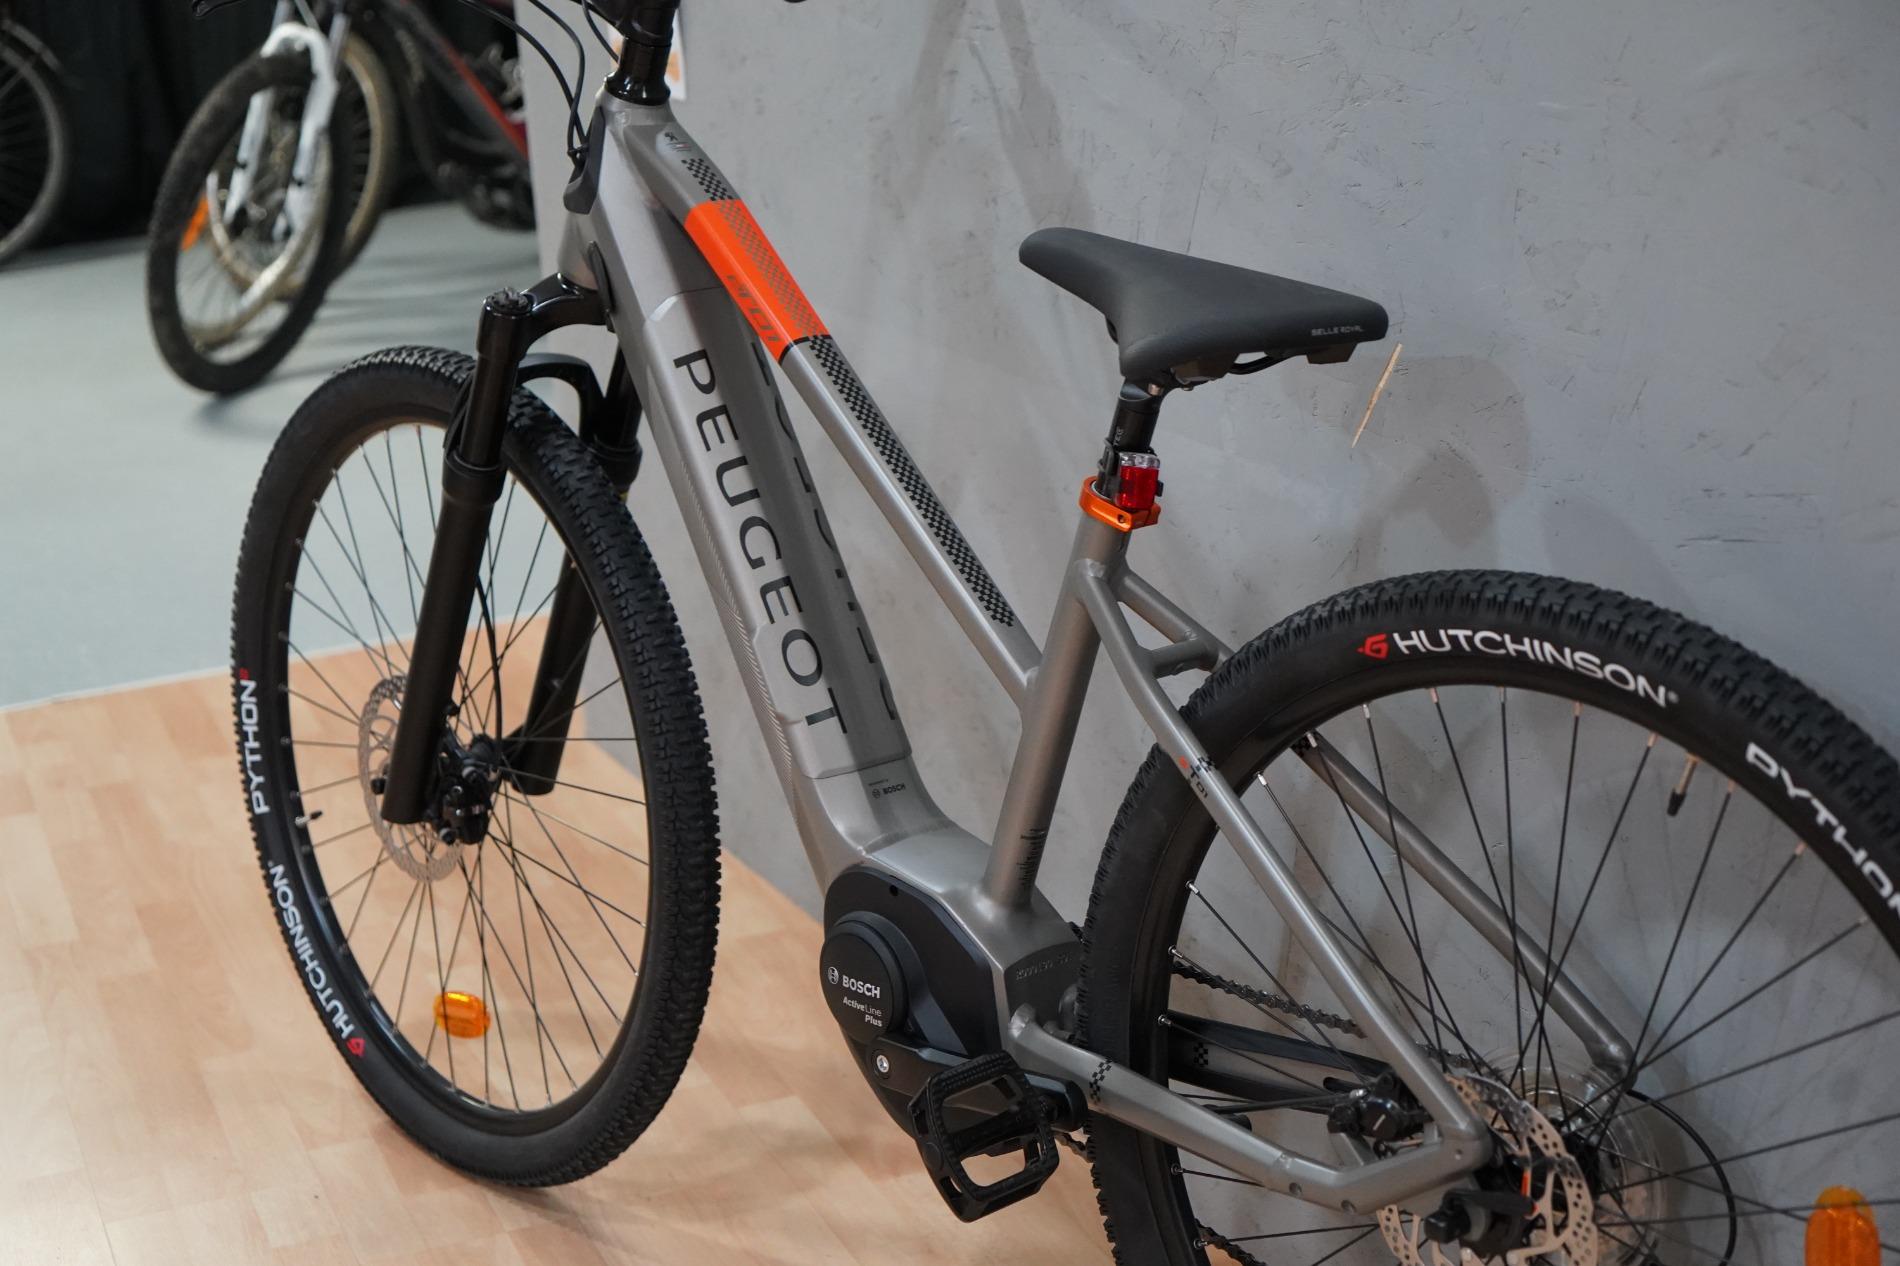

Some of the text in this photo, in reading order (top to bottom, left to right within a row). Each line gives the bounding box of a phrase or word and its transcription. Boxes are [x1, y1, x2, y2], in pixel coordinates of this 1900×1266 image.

[673, 348, 848, 734] PEUGEOT
[1394, 629, 1666, 706] HUTCHINSON
[240, 679, 270, 815] PYTHON
[882, 783, 906, 795] BOSCH
[268, 864, 354, 1040] HUTCHINSON
[842, 974, 880, 998] BOSCH
[864, 1014, 882, 1027] Plus
